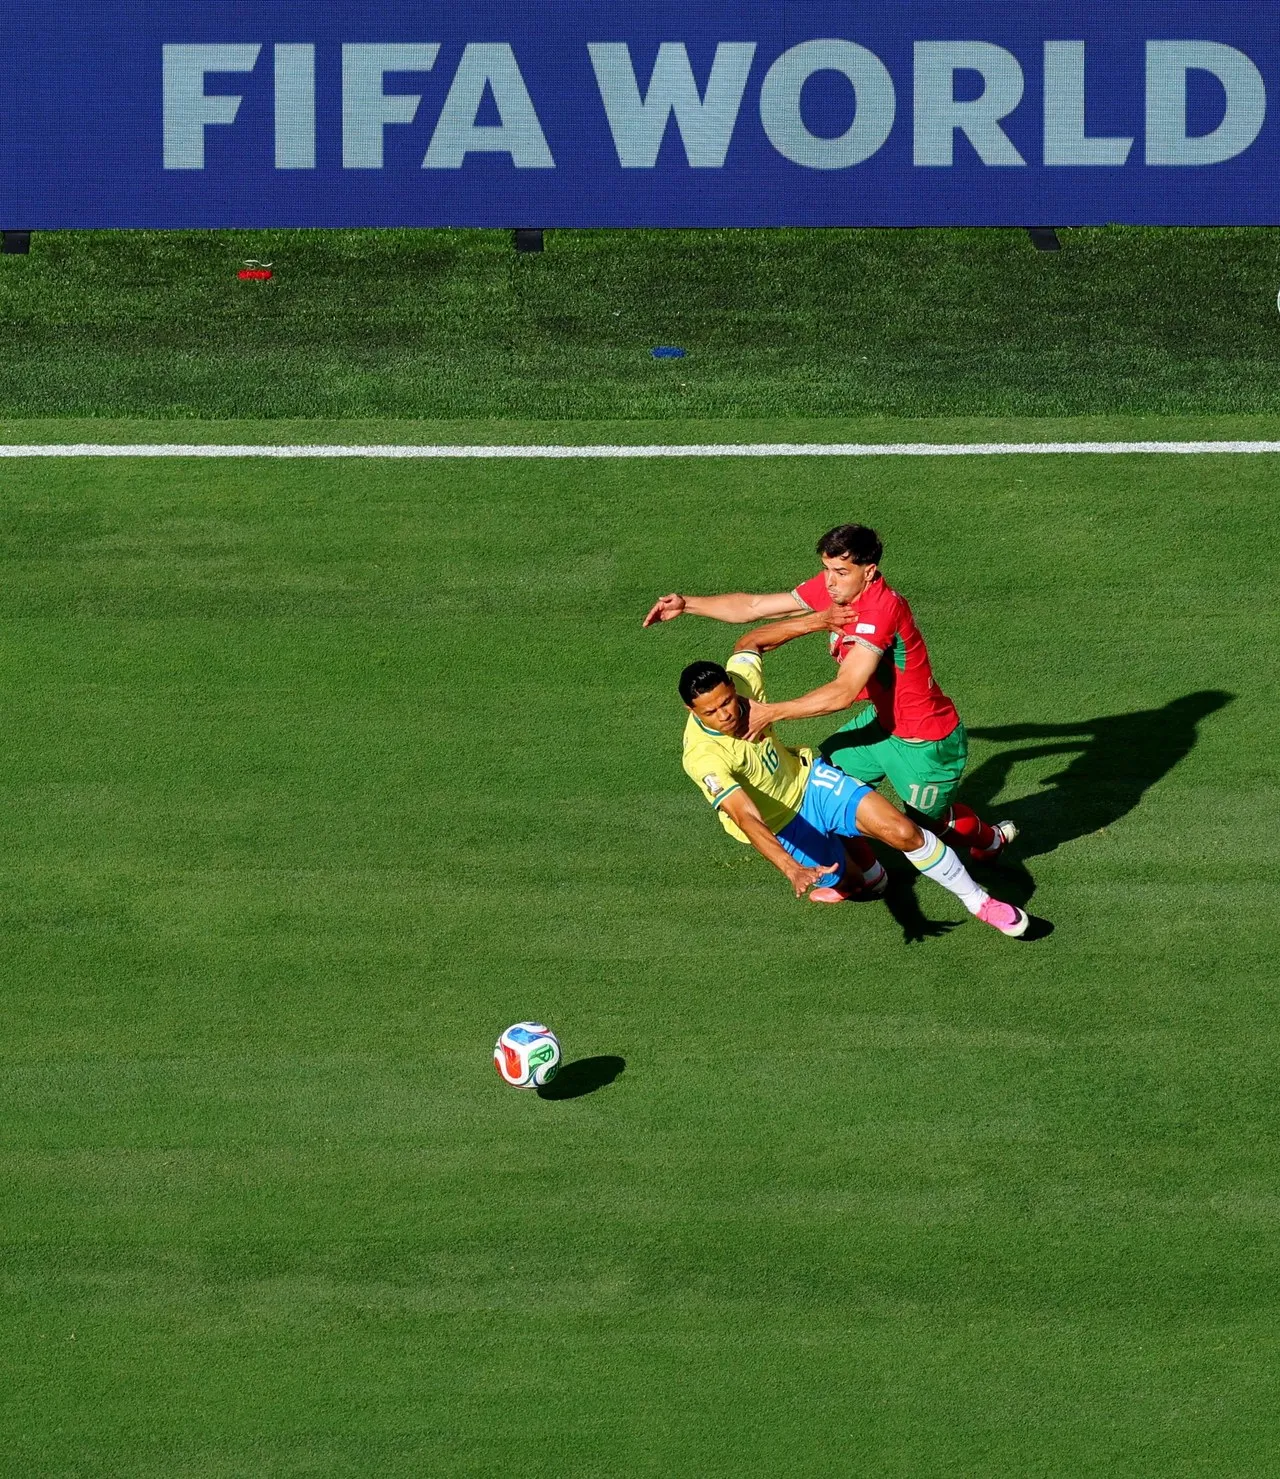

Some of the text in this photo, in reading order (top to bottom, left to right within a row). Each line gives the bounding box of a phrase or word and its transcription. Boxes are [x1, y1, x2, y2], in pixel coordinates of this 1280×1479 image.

[162, 42, 556, 170] FIFA
[587, 39, 1266, 169] WORLD
[761, 742, 780, 776] 16
[811, 765, 841, 790] 16
[906, 783, 939, 810] 10
